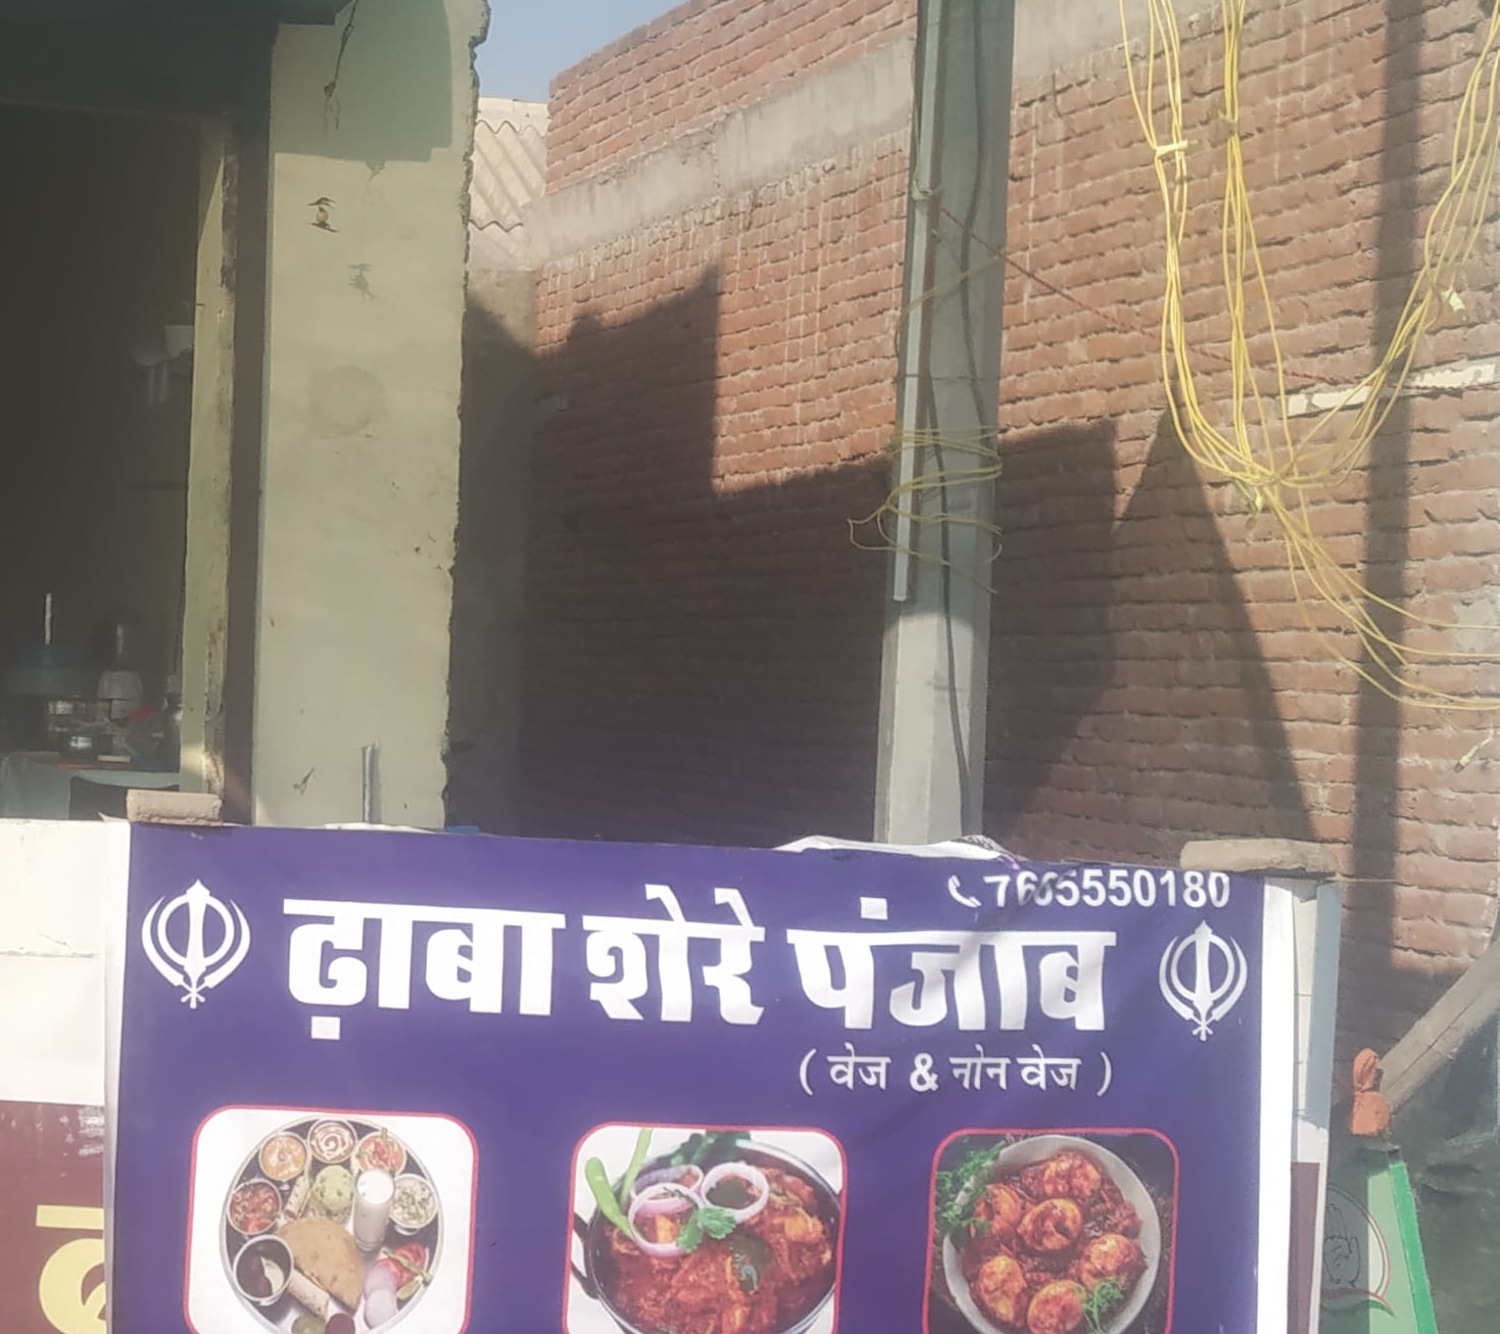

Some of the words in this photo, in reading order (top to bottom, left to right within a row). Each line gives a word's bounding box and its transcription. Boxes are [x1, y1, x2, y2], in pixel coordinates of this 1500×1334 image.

[583, 884, 765, 1024] शेरे
[786, 897, 1116, 1030] पंजाब
[910, 1054, 938, 1091] &
